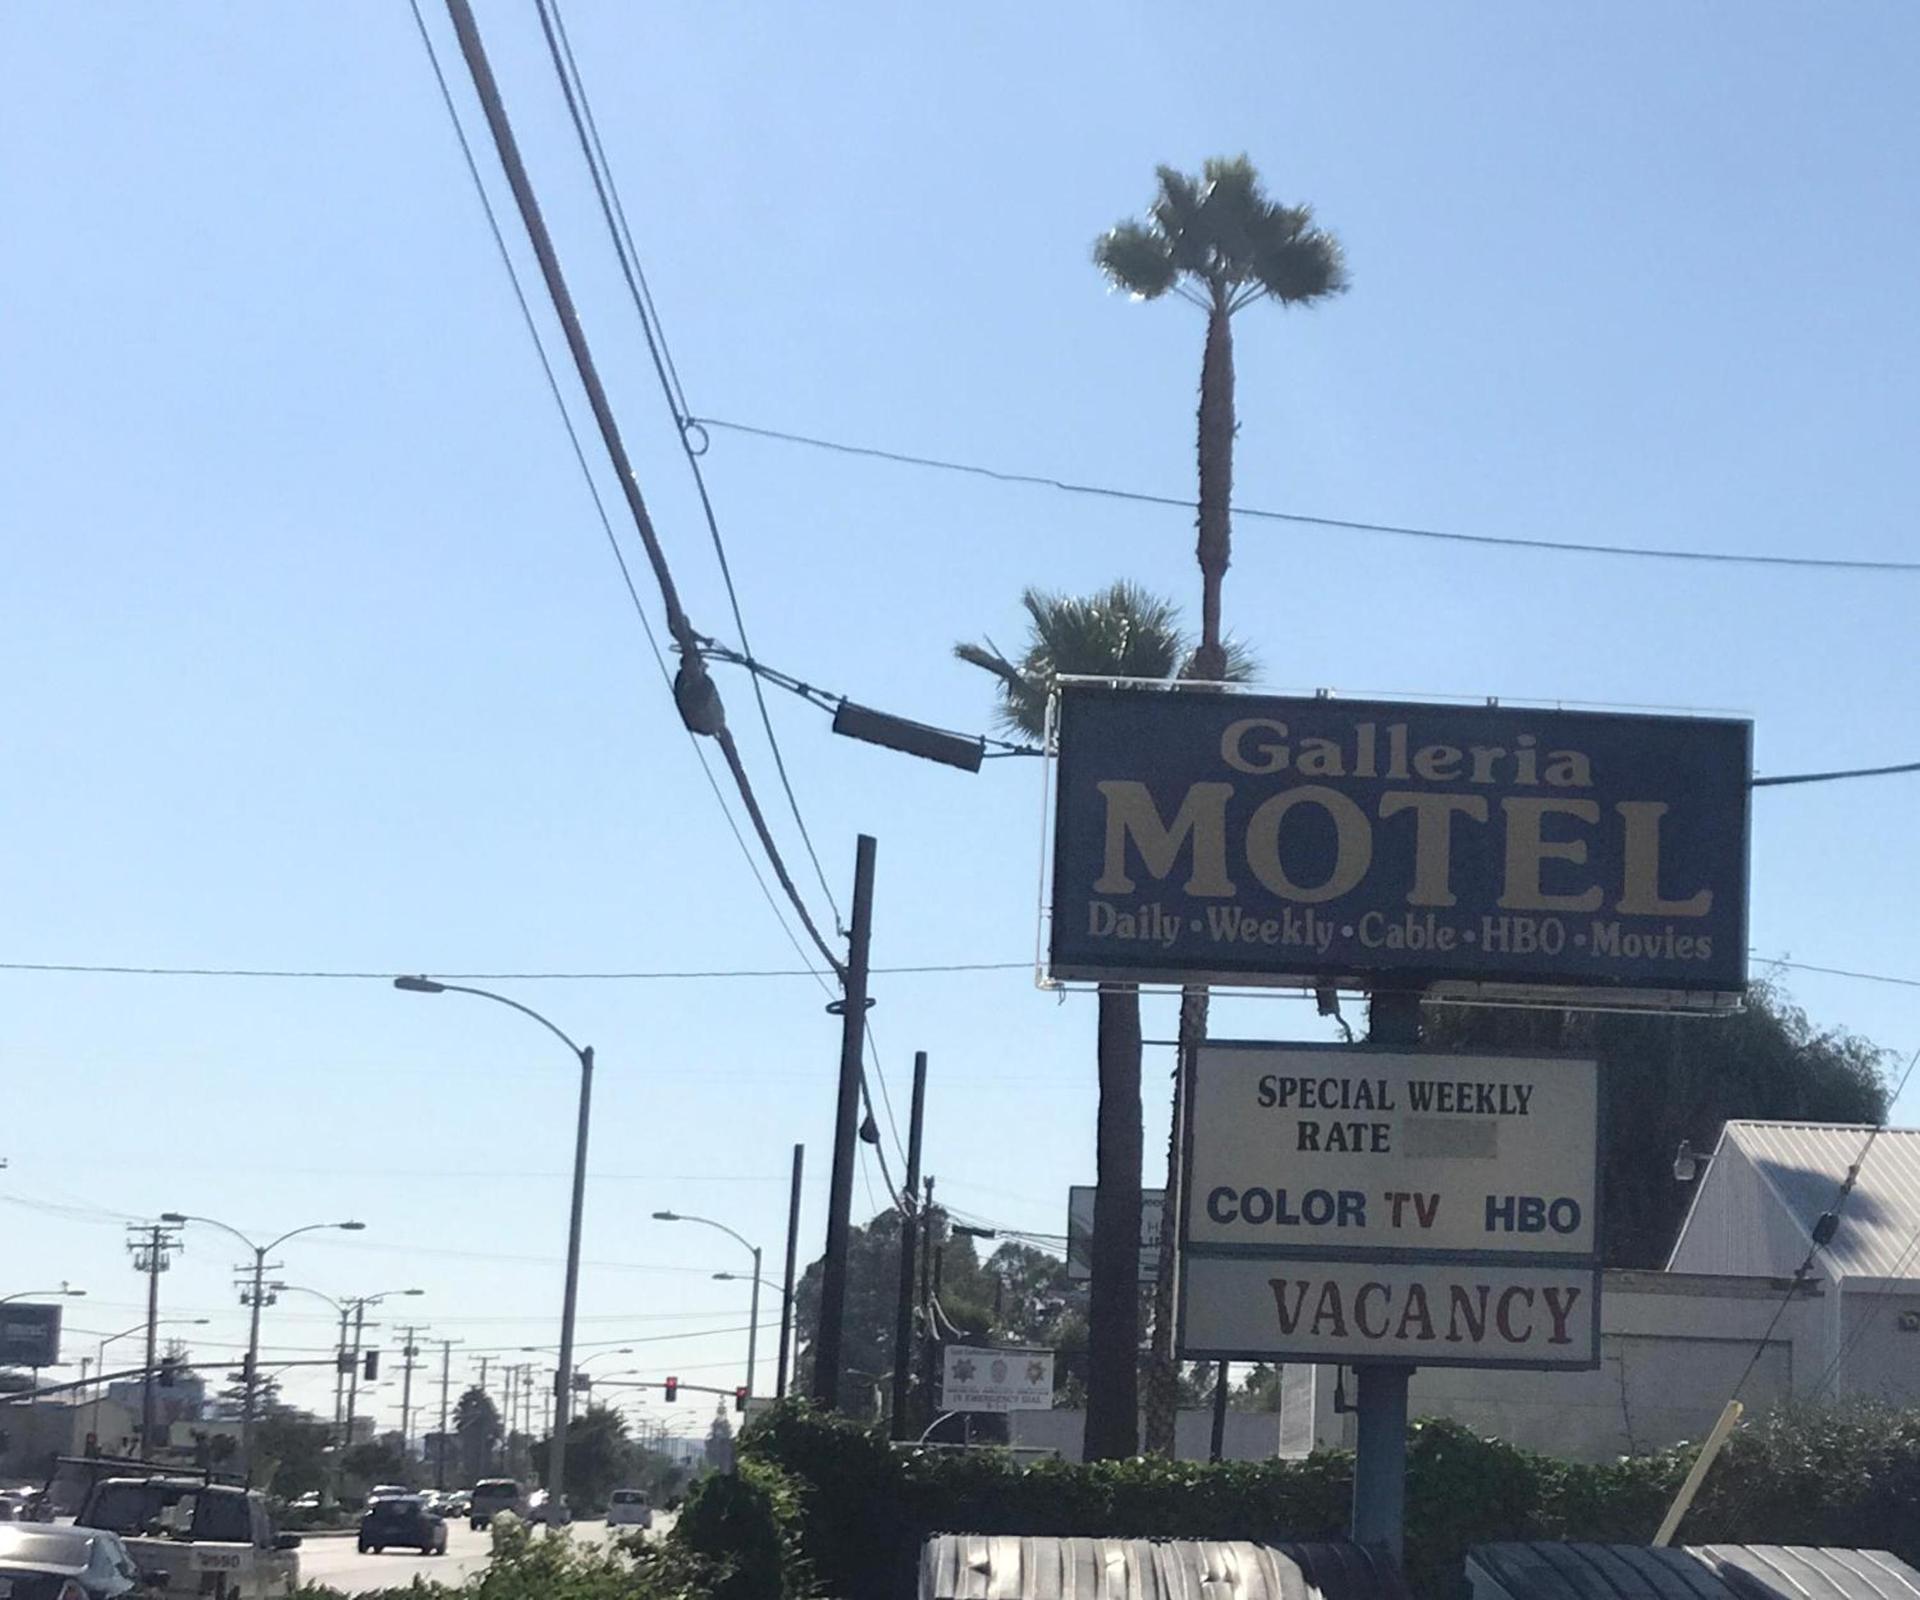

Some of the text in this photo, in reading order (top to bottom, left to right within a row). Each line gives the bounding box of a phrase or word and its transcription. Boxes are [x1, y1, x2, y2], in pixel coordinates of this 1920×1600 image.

[1220, 719, 1592, 786] Galleria
[1093, 781, 1712, 916] MOTEL
[1087, 900, 1713, 960] Daily Weekly Cable HBO Movies
[1257, 1075, 1534, 1116] SPECIAL WEEKLY
[1296, 1120, 1391, 1153] RATE
[1206, 1185, 1582, 1235] COLOR TV HBO
[1267, 1278, 1581, 1345] VACANCY
